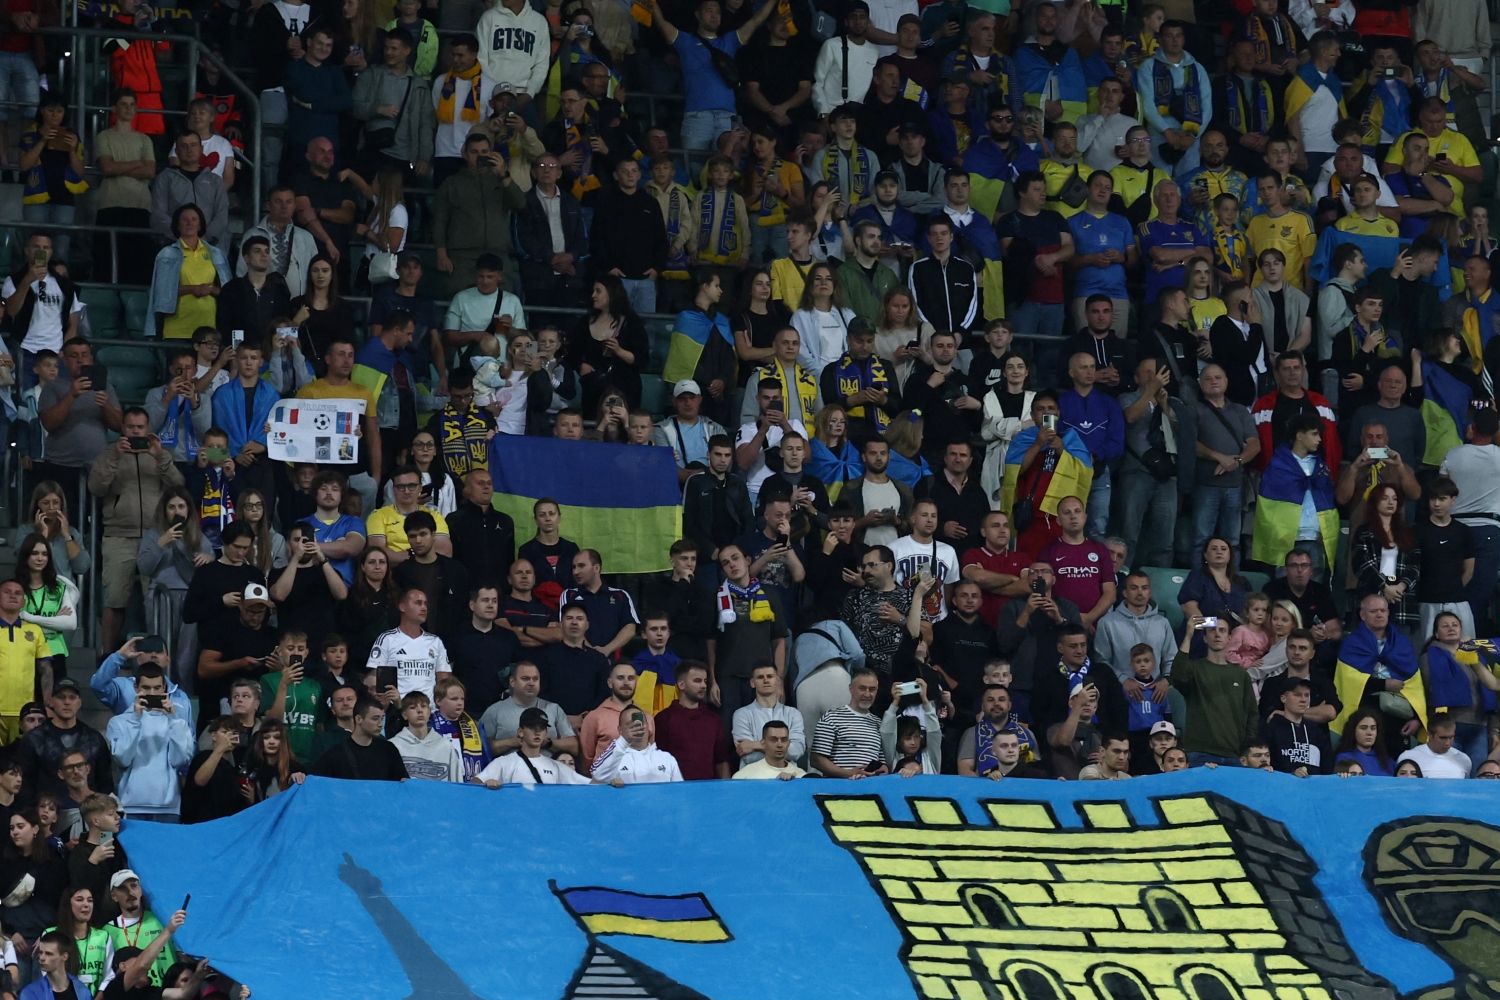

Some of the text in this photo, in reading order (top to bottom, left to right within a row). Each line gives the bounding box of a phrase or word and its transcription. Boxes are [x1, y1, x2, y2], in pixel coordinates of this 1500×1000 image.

[493, 27, 536, 56] GTSR
[1057, 566, 1099, 575] ETIHAD
[397, 659, 435, 671] Emirates
[1142, 700, 1152, 714] 10
[1294, 741, 1310, 750] THE
[1281, 748, 1310, 758] NORTH
[1290, 755, 1310, 764] FACE
